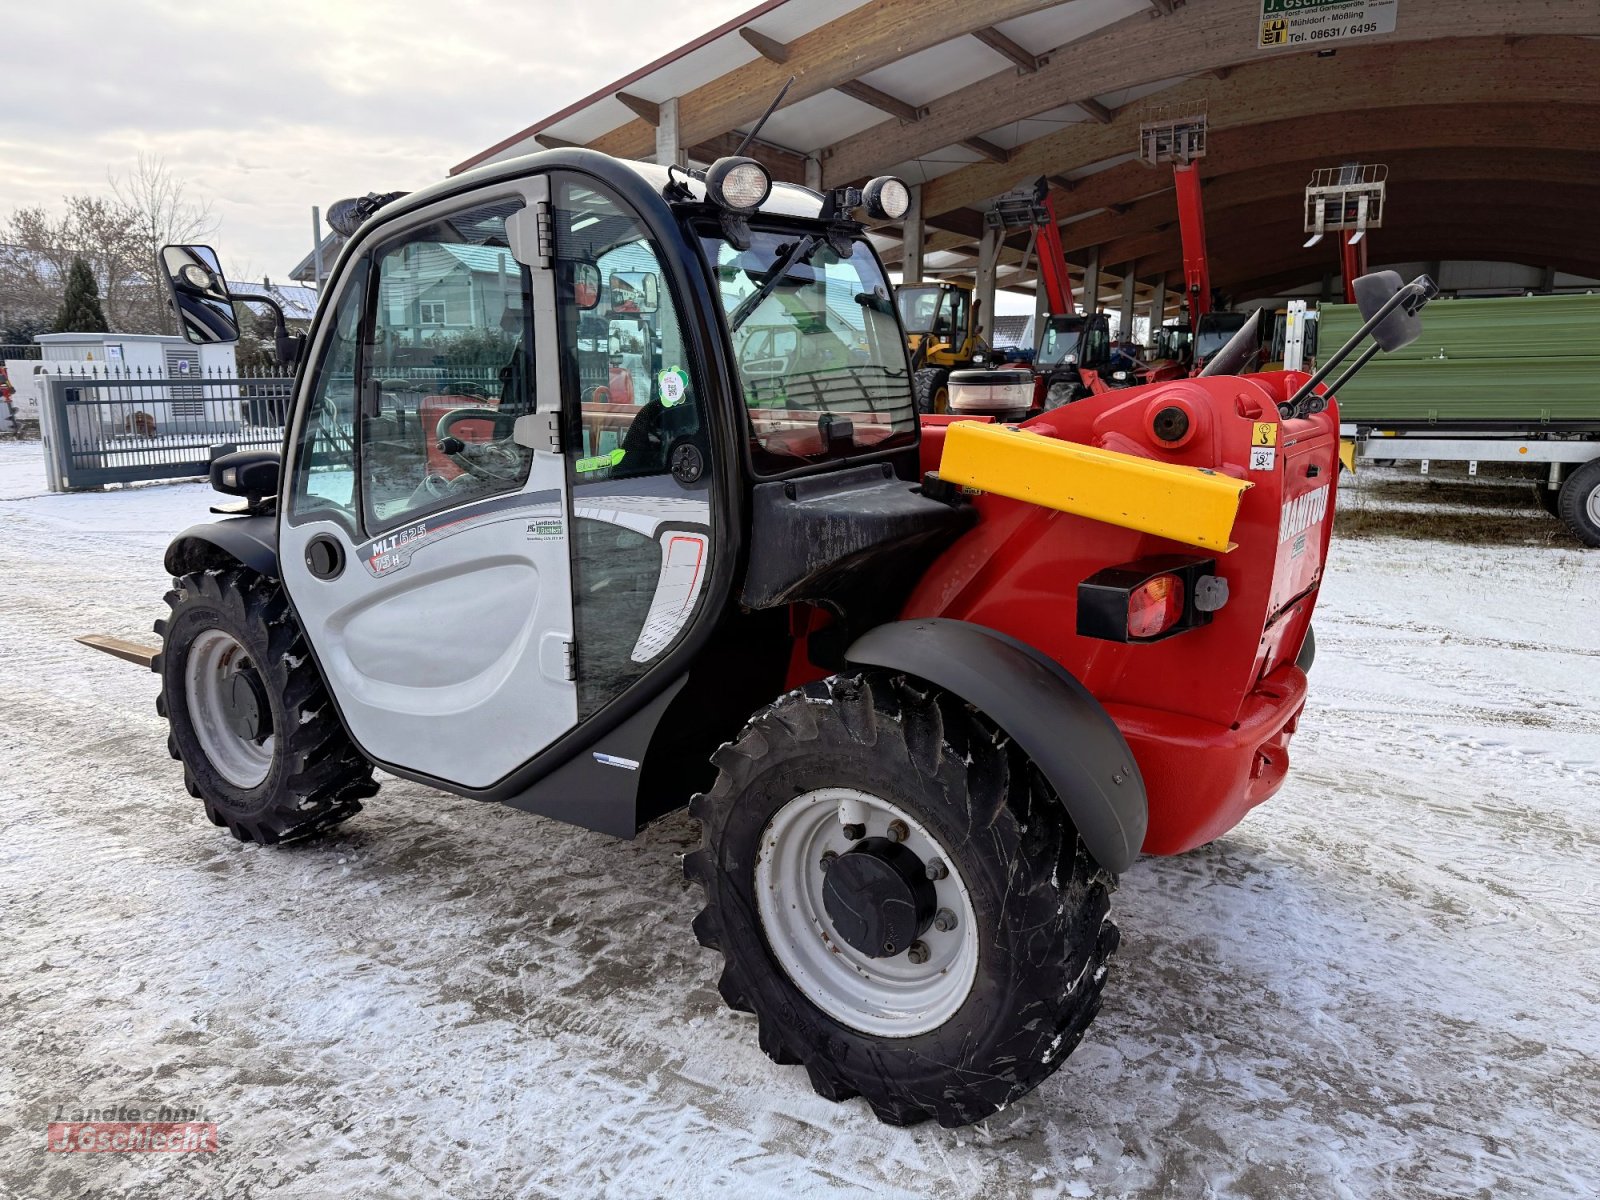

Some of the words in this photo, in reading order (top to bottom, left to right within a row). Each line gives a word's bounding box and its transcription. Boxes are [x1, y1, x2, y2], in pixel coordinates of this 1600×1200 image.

[1290, 16, 1325, 27] Mühldorf
[1331, 11, 1364, 21] Mößling
[1289, 32, 1307, 43] Tel.
[1350, 22, 1377, 35] 6495
[1280, 484, 1329, 545] MANITOU
[372, 534, 399, 556] MLT
[399, 524, 426, 545] 625
[374, 555, 390, 572] 75
[392, 554, 400, 566] H
